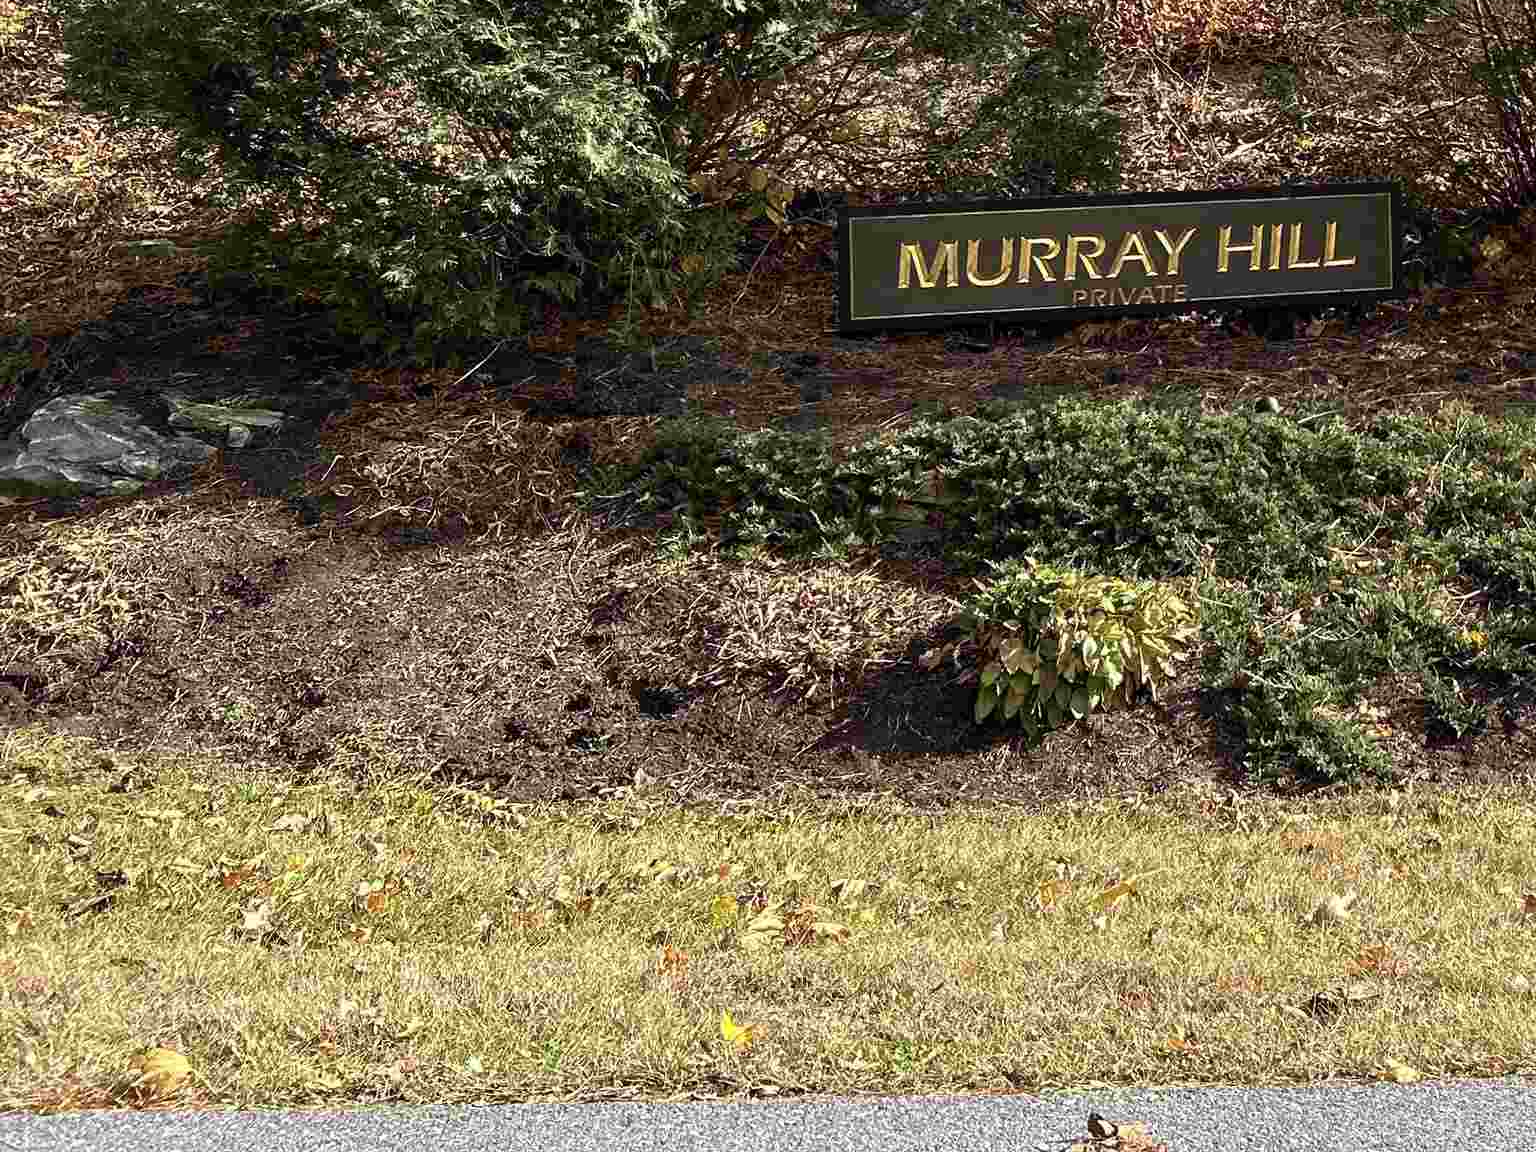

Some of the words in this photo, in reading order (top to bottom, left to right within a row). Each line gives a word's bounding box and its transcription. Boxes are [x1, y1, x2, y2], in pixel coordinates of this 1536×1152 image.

[897, 226, 1197, 289] MURRAY
[1216, 220, 1357, 273] HILL
[1071, 284, 1188, 308] PRIVATE
